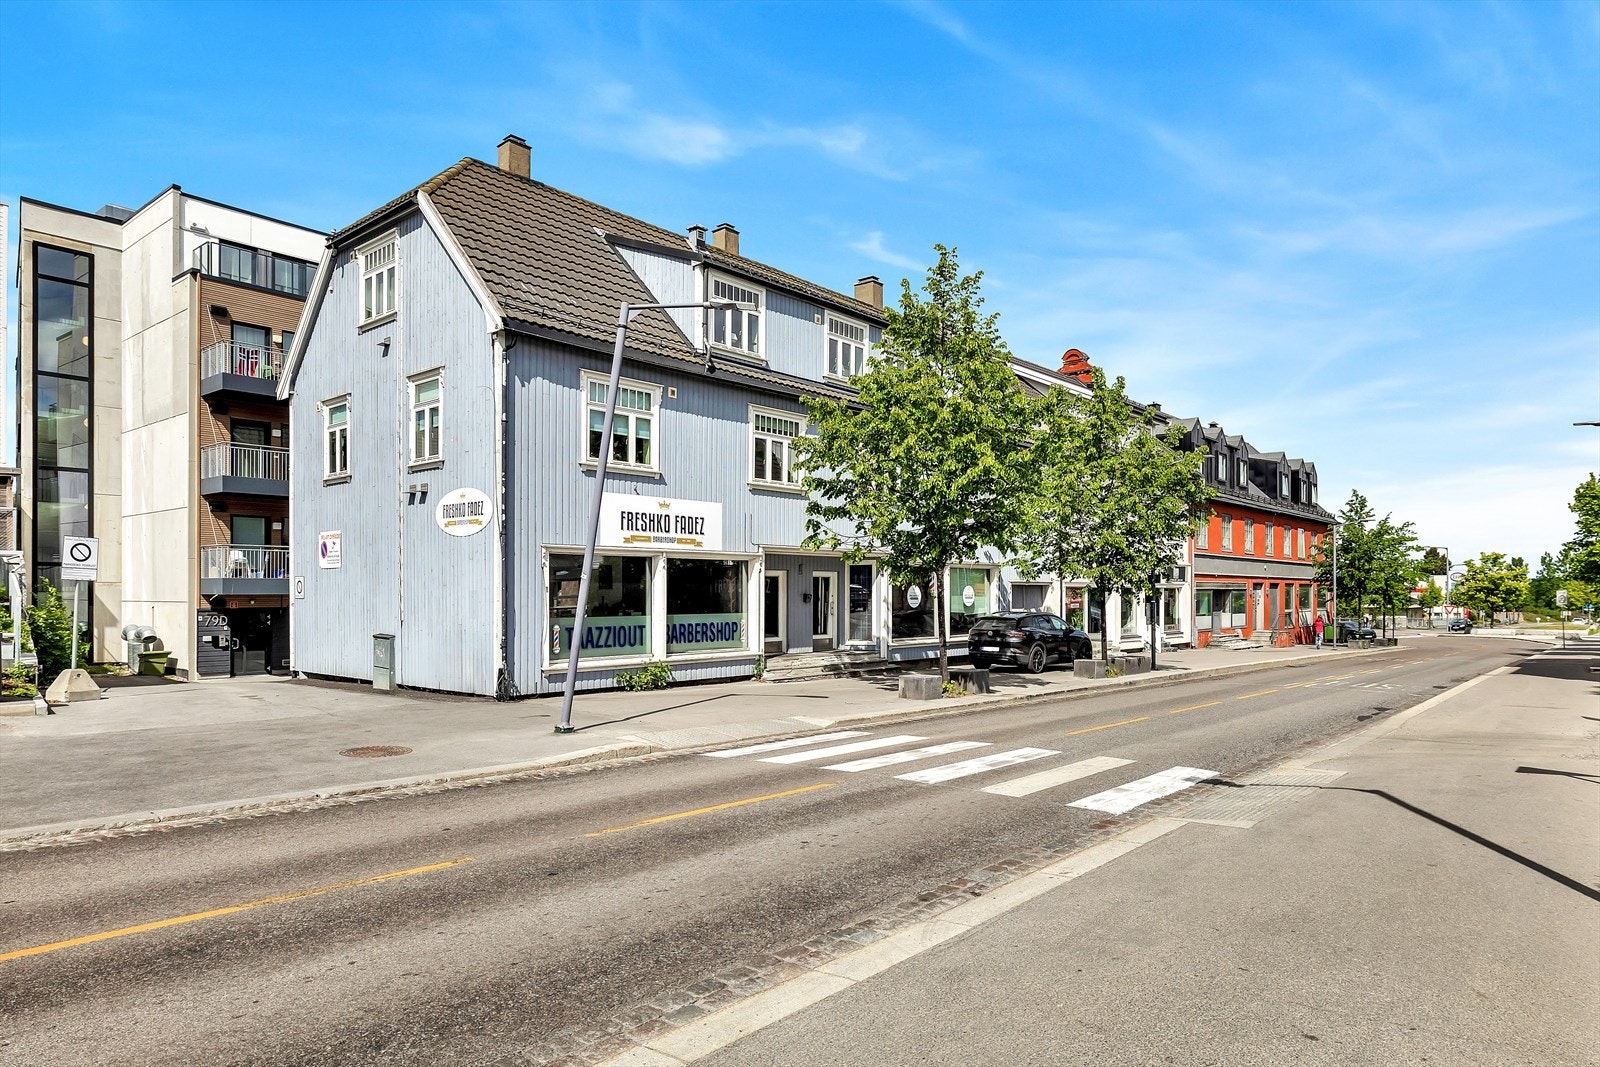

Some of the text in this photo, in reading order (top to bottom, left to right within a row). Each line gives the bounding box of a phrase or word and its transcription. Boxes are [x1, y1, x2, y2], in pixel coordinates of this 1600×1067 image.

[443, 500, 484, 519] FRESHKO FADEZ
[620, 511, 705, 536] FRESHKO FADEZ
[203, 615, 228, 626] 79D
[666, 621, 738, 644] BARBERSHOP
